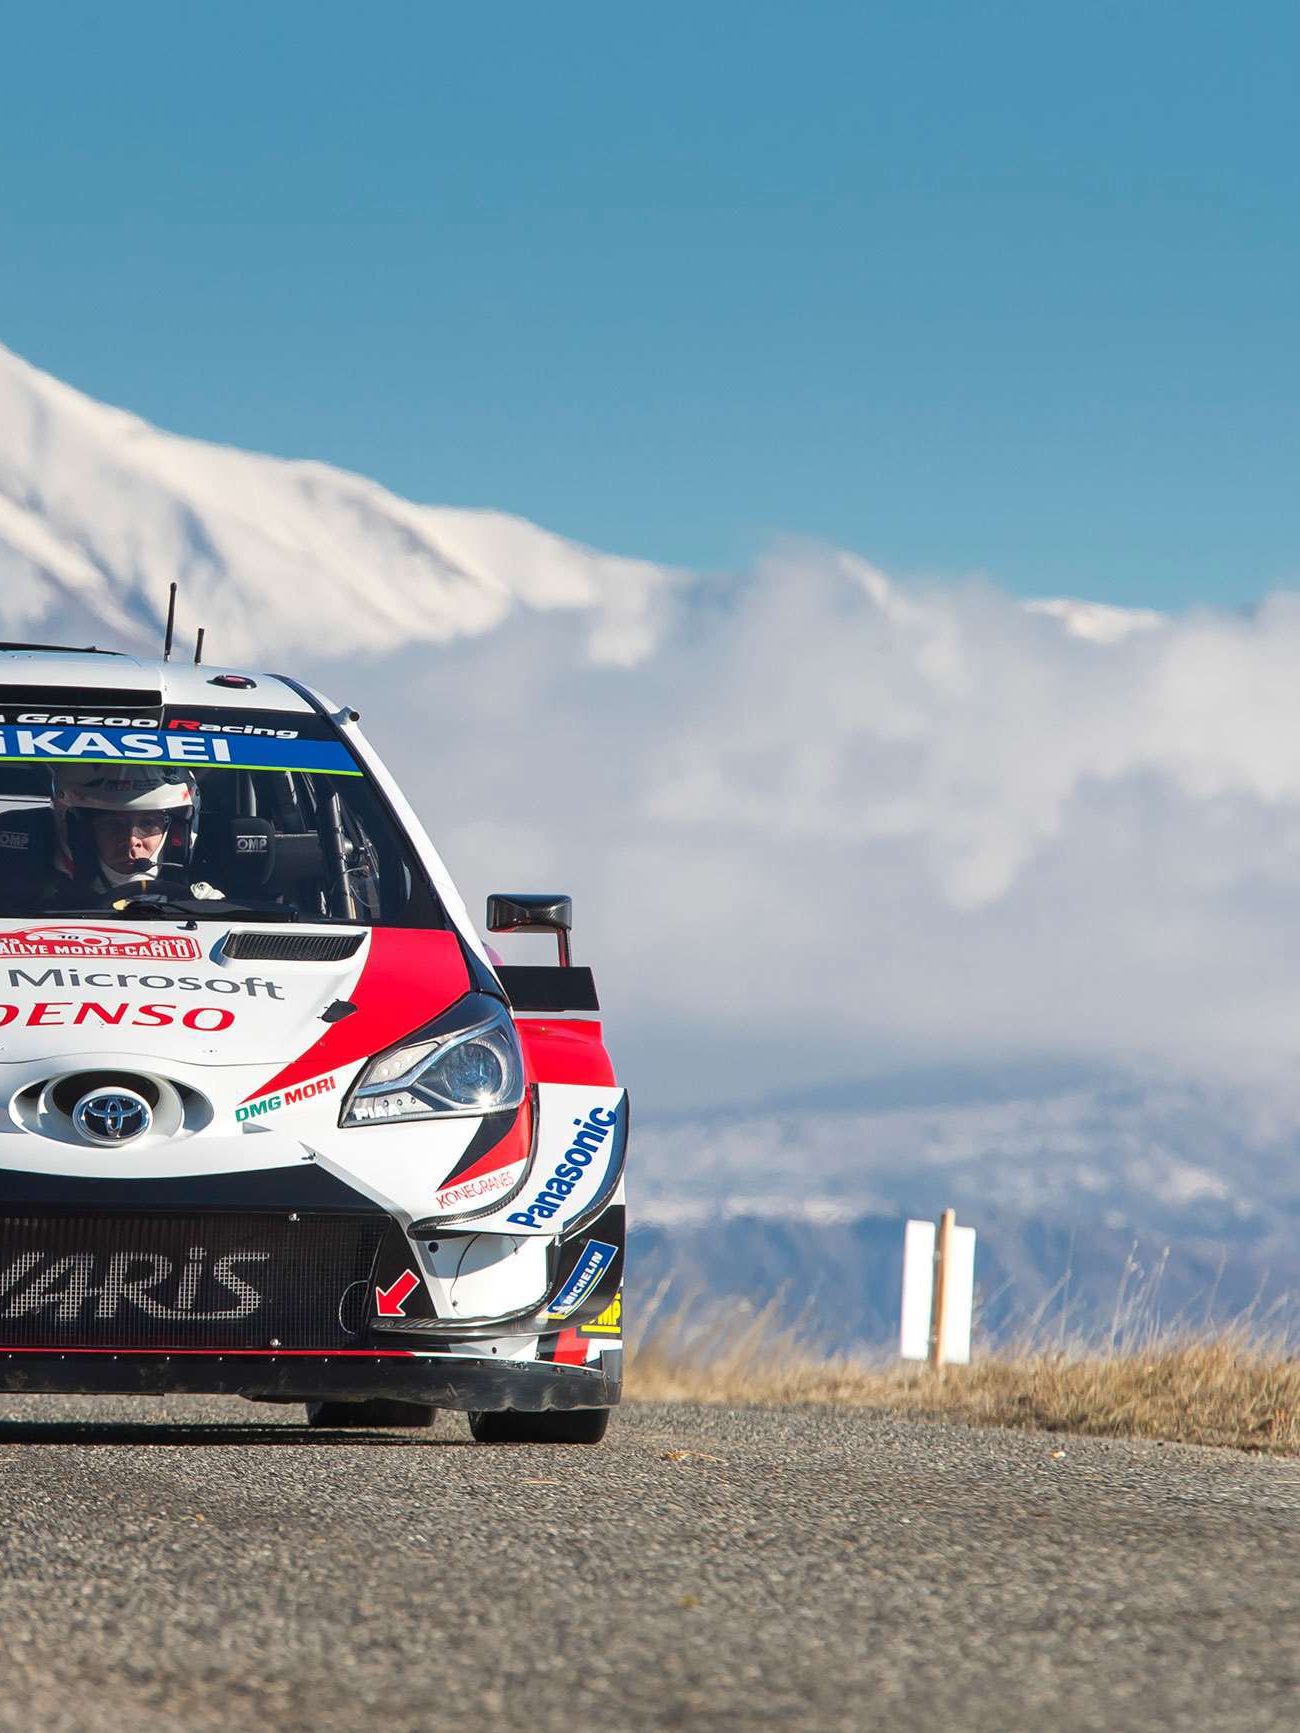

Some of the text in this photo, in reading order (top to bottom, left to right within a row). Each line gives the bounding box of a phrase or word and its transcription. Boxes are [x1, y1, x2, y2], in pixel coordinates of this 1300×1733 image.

[17, 713, 159, 729] GAZOO
[168, 719, 299, 739] Racing
[237, 837, 268, 850] OMP
[53, 941, 190, 958] MONTE-CARLO
[8, 968, 286, 1001] Microsoft
[235, 1075, 337, 1123] DMG MORI
[354, 1102, 402, 1121] PIAA
[506, 1106, 618, 1229] Panasonic
[436, 1171, 515, 1210] KONECRANES
[562, 1251, 604, 1307] MICHELIN
